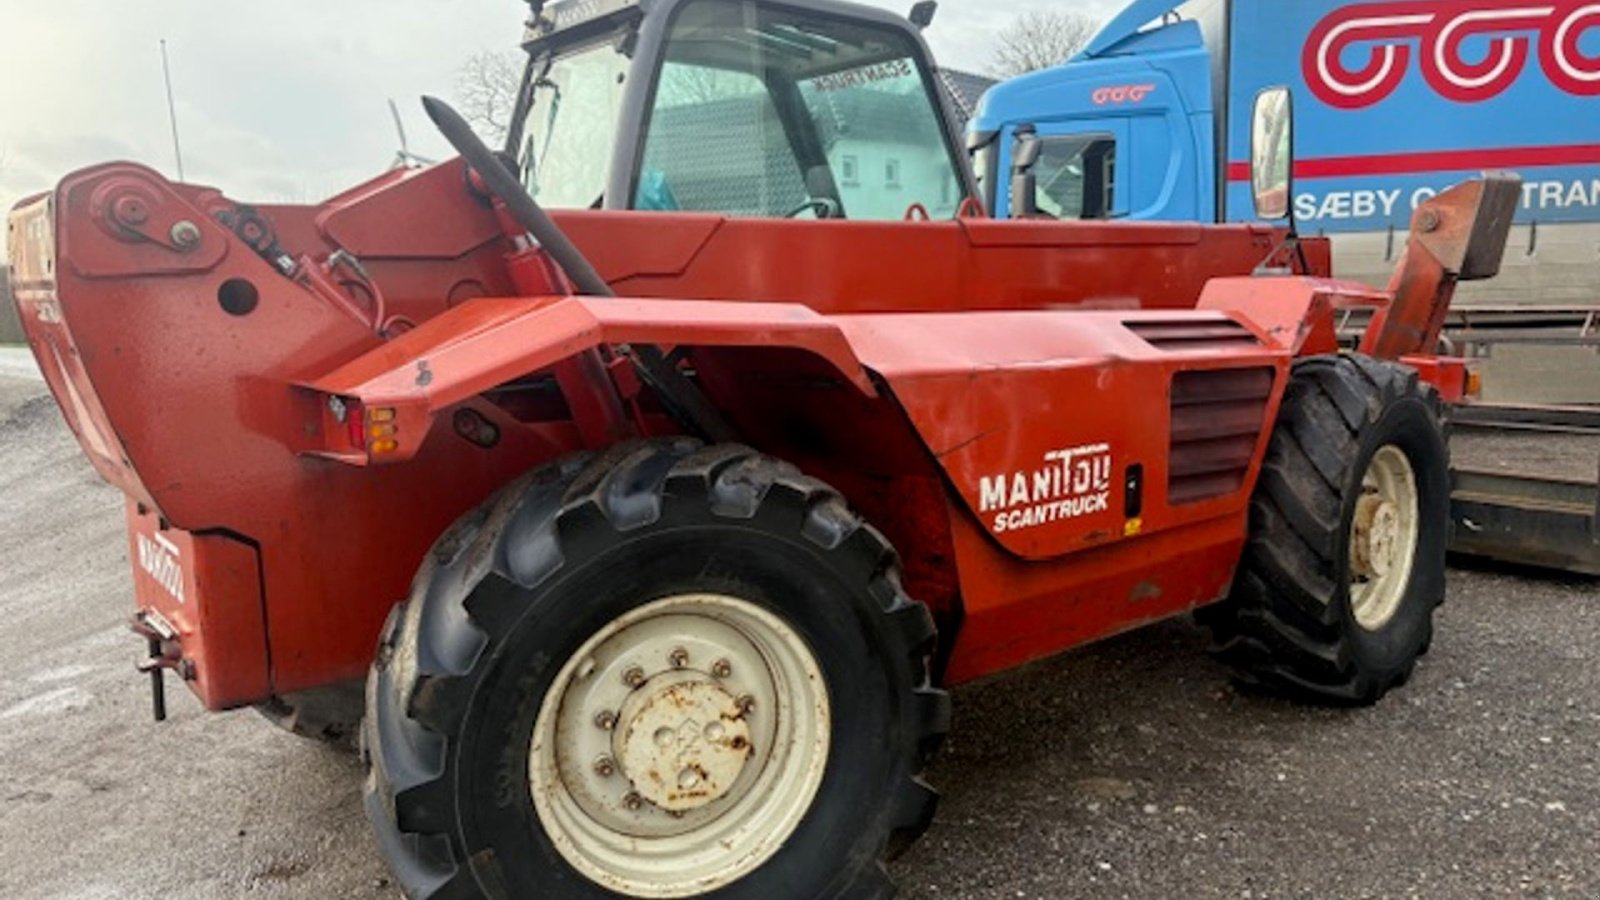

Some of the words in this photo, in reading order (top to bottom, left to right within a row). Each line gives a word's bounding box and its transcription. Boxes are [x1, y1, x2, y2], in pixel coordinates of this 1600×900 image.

[1295, 189, 1401, 220] SÆBY
[979, 443, 1110, 511] MANITOU
[993, 492, 1109, 532] SCANTRUCK
